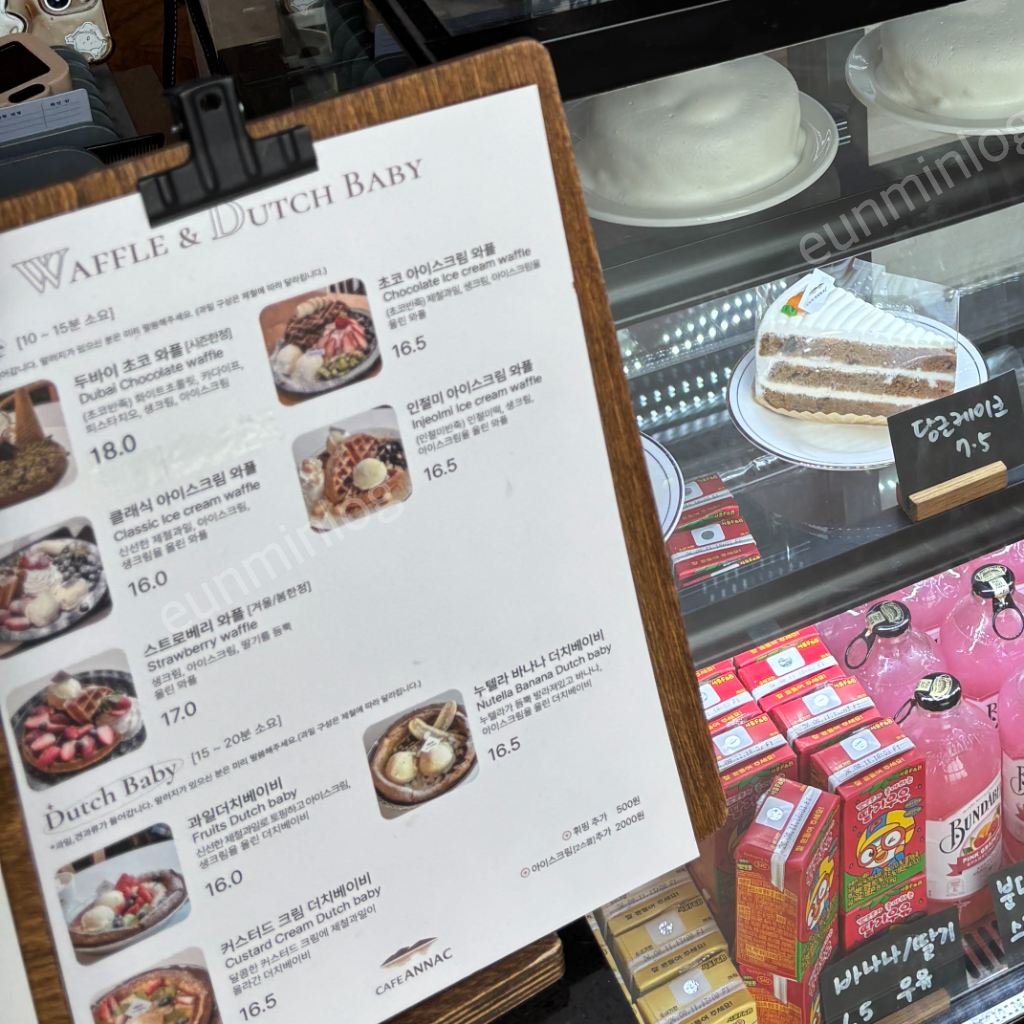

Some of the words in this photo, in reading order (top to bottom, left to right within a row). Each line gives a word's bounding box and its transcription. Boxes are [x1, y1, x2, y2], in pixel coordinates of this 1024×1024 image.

[12, 236, 169, 294] WAFFLE
[179, 228, 201, 248] &
[209, 185, 334, 241] DUTCH
[342, 158, 424, 200] BABY
[378, 272, 404, 290] 초코
[406, 250, 468, 279] 아이스크림
[471, 242, 496, 259] 와플
[383, 276, 440, 302] Chocolate
[461, 260, 496, 276] cream
[498, 248, 531, 265] waffle
[74, 364, 119, 388] 두바이
[122, 353, 151, 373] 초코
[155, 342, 183, 362] 와플
[392, 335, 427, 358] 16.5
[79, 383, 118, 404] Dubai
[119, 363, 184, 390] Chocolate
[186, 349, 224, 367] waffle
[407, 391, 444, 415] 인절미
[447, 368, 507, 398] 아이스크림
[509, 359, 533, 376] 와플
[412, 406, 453, 429] Injeolmi
[474, 387, 508, 406] cream
[509, 375, 542, 392] waffle
[90, 434, 137, 464] 18.0
[424, 458, 457, 481] 16.5
[956, 431, 992, 458] 7.5
[110, 498, 153, 525] 클래식
[156, 471, 226, 505] 아이스크림
[230, 460, 257, 479] 와플
[113, 518, 160, 542] Classic
[183, 496, 222, 517] cream
[223, 481, 261, 500] waffle
[128, 571, 168, 597] 16.0
[144, 619, 214, 657] 스트로베리
[217, 606, 245, 627] 와플
[147, 637, 217, 672] Strawberry
[220, 620, 258, 642] waffle
[474, 672, 509, 698] 누텔라
[511, 656, 546, 679] 바나나
[549, 629, 605, 662] 더치베이비
[477, 689, 514, 711] Nutella
[515, 671, 554, 693] Banana
[556, 656, 585, 675] Dutch
[587, 644, 612, 661] baby
[161, 701, 197, 726] 17.0
[224, 729, 251, 748] 20분
[255, 715, 282, 735] 소요]
[488, 736, 521, 761] 16.5
[46, 788, 118, 831] Dutch
[123, 760, 179, 797] Baby
[188, 776, 283, 829] 과일더치베이비
[192, 821, 227, 844] Fruits
[230, 804, 266, 826] Dutch
[268, 788, 298, 808] baby
[572, 820, 590, 836] 휘핑
[591, 812, 608, 827] 추가
[616, 796, 641, 815] 500원
[241, 835, 260, 851] 올린
[262, 811, 310, 839] 더치베이비
[205, 869, 243, 897] 16.0
[221, 921, 275, 954] 커스터드
[279, 905, 305, 926] 크림
[307, 871, 372, 912] 더치베이비
[225, 937, 272, 969] Custard
[274, 920, 314, 944] Cream
[316, 902, 350, 923] Dutch
[353, 886, 382, 906] baby
[229, 961, 258, 984] 달콤한
[261, 944, 299, 968] 커스터드
[301, 927, 330, 948] 크림에
[263, 951, 312, 979] 더치베이비
[239, 992, 277, 1021] 16.5
[896, 968, 933, 1003] 우유
